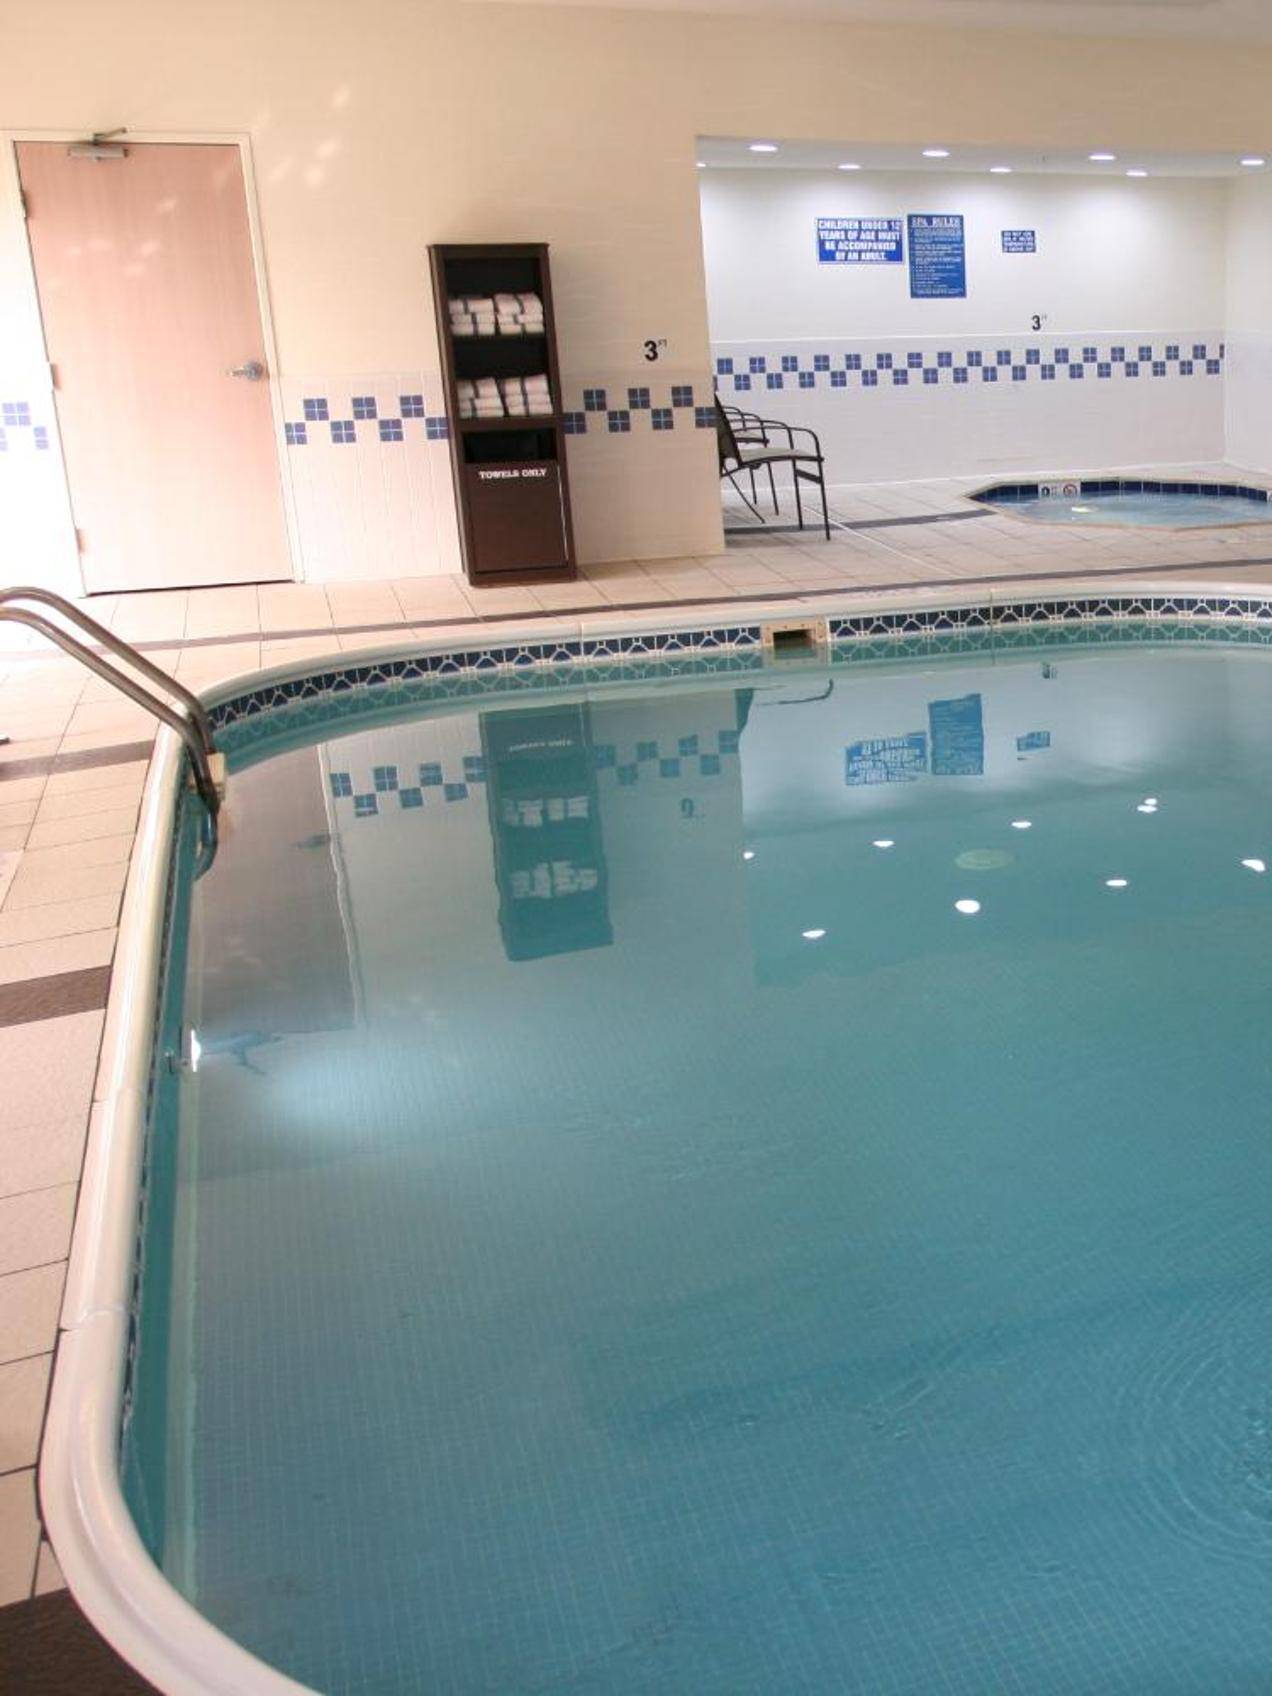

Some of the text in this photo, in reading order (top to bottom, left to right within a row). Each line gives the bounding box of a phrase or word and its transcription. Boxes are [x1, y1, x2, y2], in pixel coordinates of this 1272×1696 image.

[818, 220, 859, 230] CHILDREN
[818, 230, 845, 240] YEARS
[847, 230, 859, 241] OF
[860, 230, 876, 241] AGE
[878, 230, 900, 241] MUST
[1031, 314, 1041, 331] 3
[644, 340, 658, 362] 3
[478, 467, 546, 480] TOWELS ONLY
